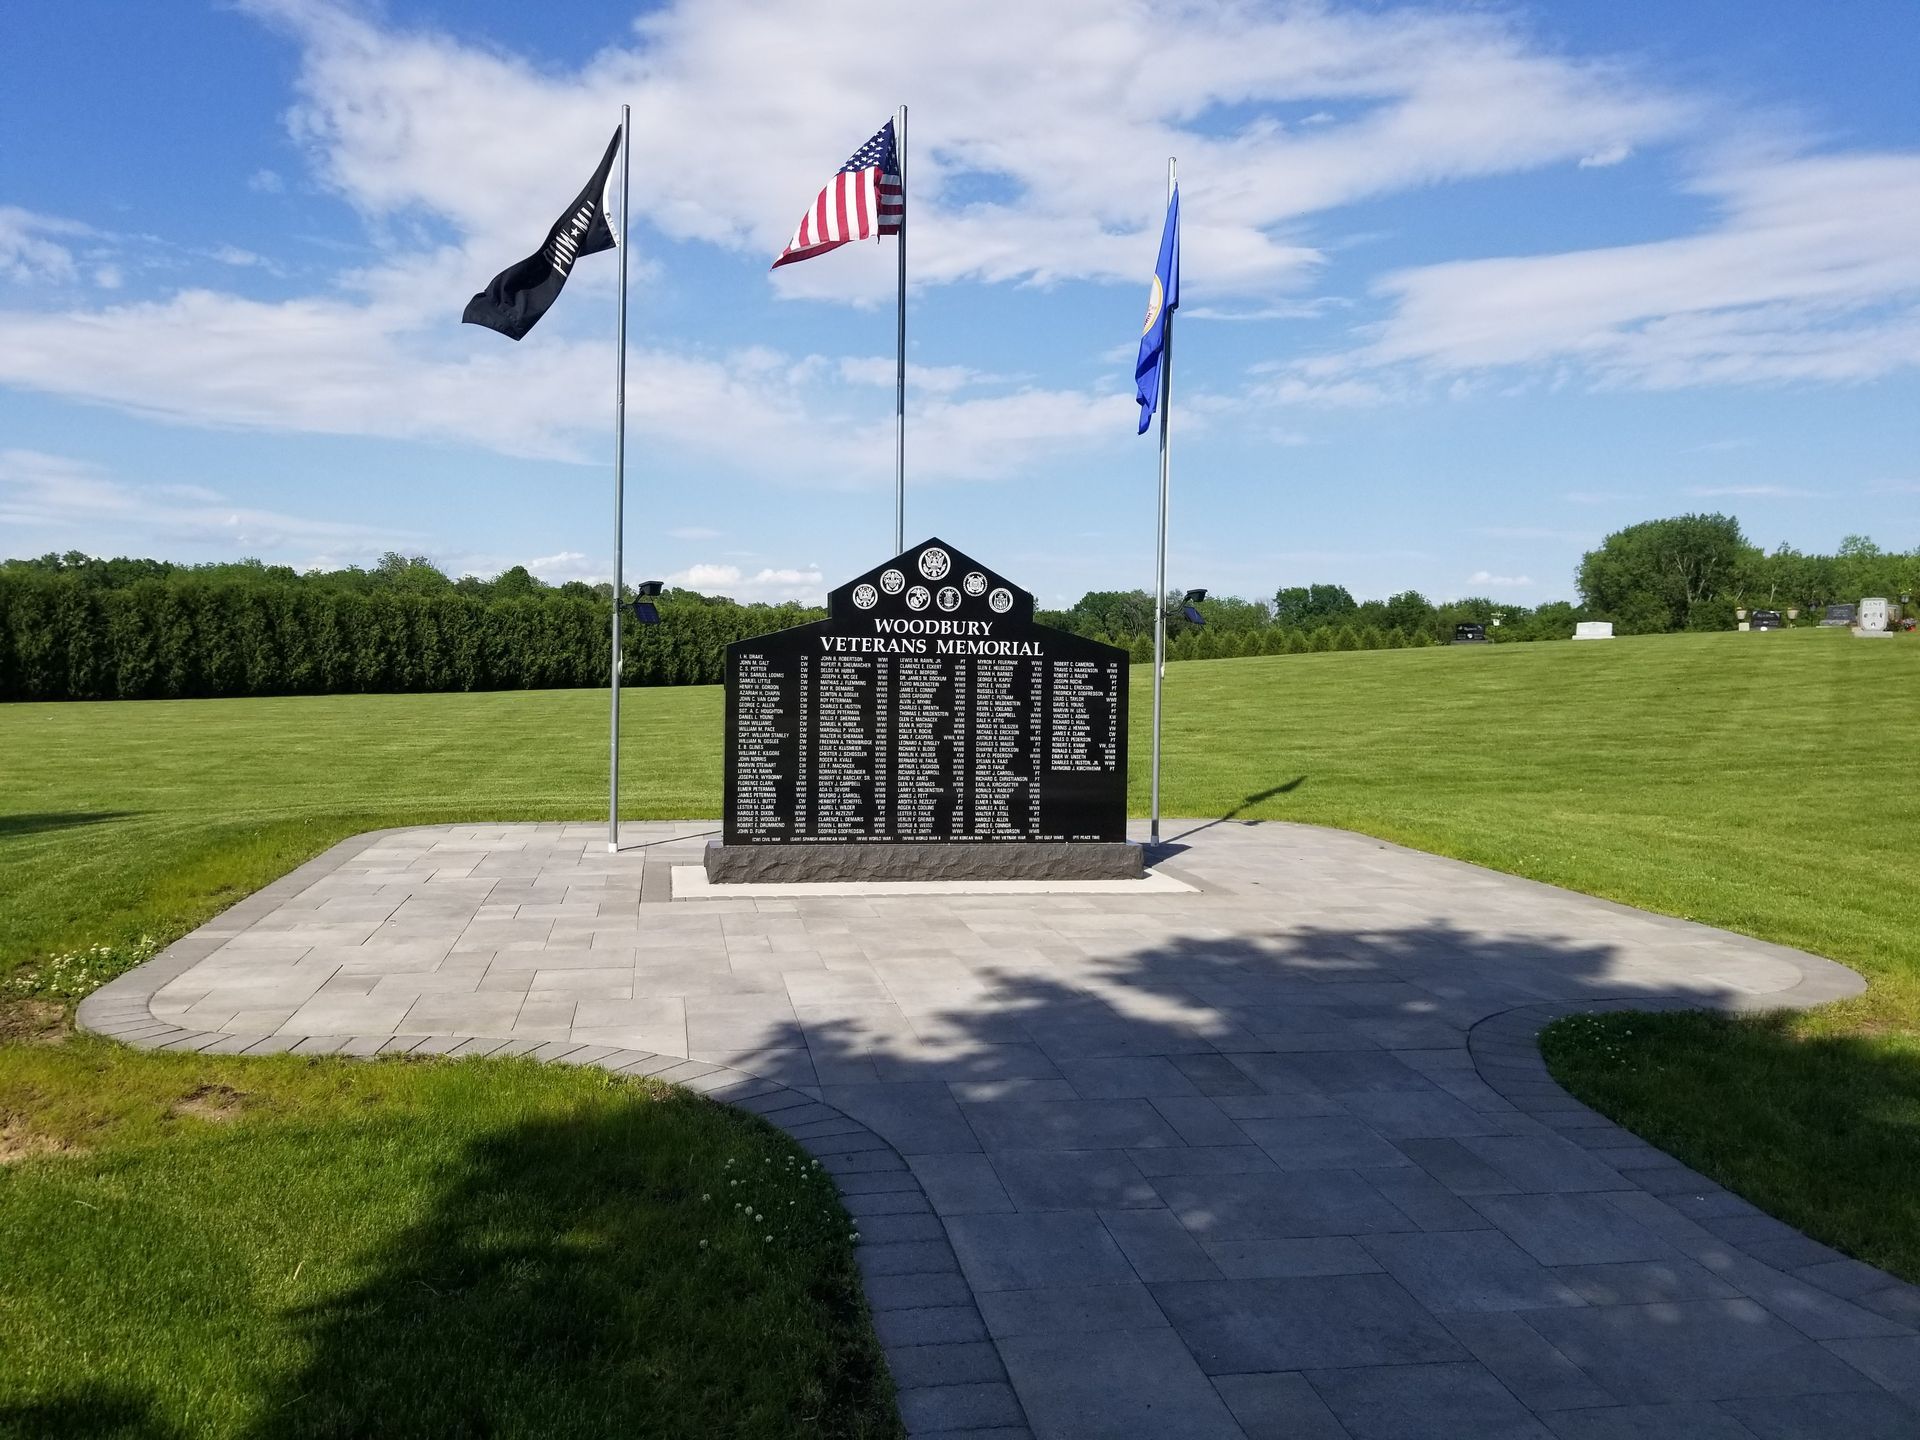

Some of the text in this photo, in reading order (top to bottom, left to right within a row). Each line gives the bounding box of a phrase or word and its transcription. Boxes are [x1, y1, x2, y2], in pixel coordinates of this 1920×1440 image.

[874, 618, 993, 636] WOODBURY
[820, 636, 1044, 656] VETERANS MEMORIAL
